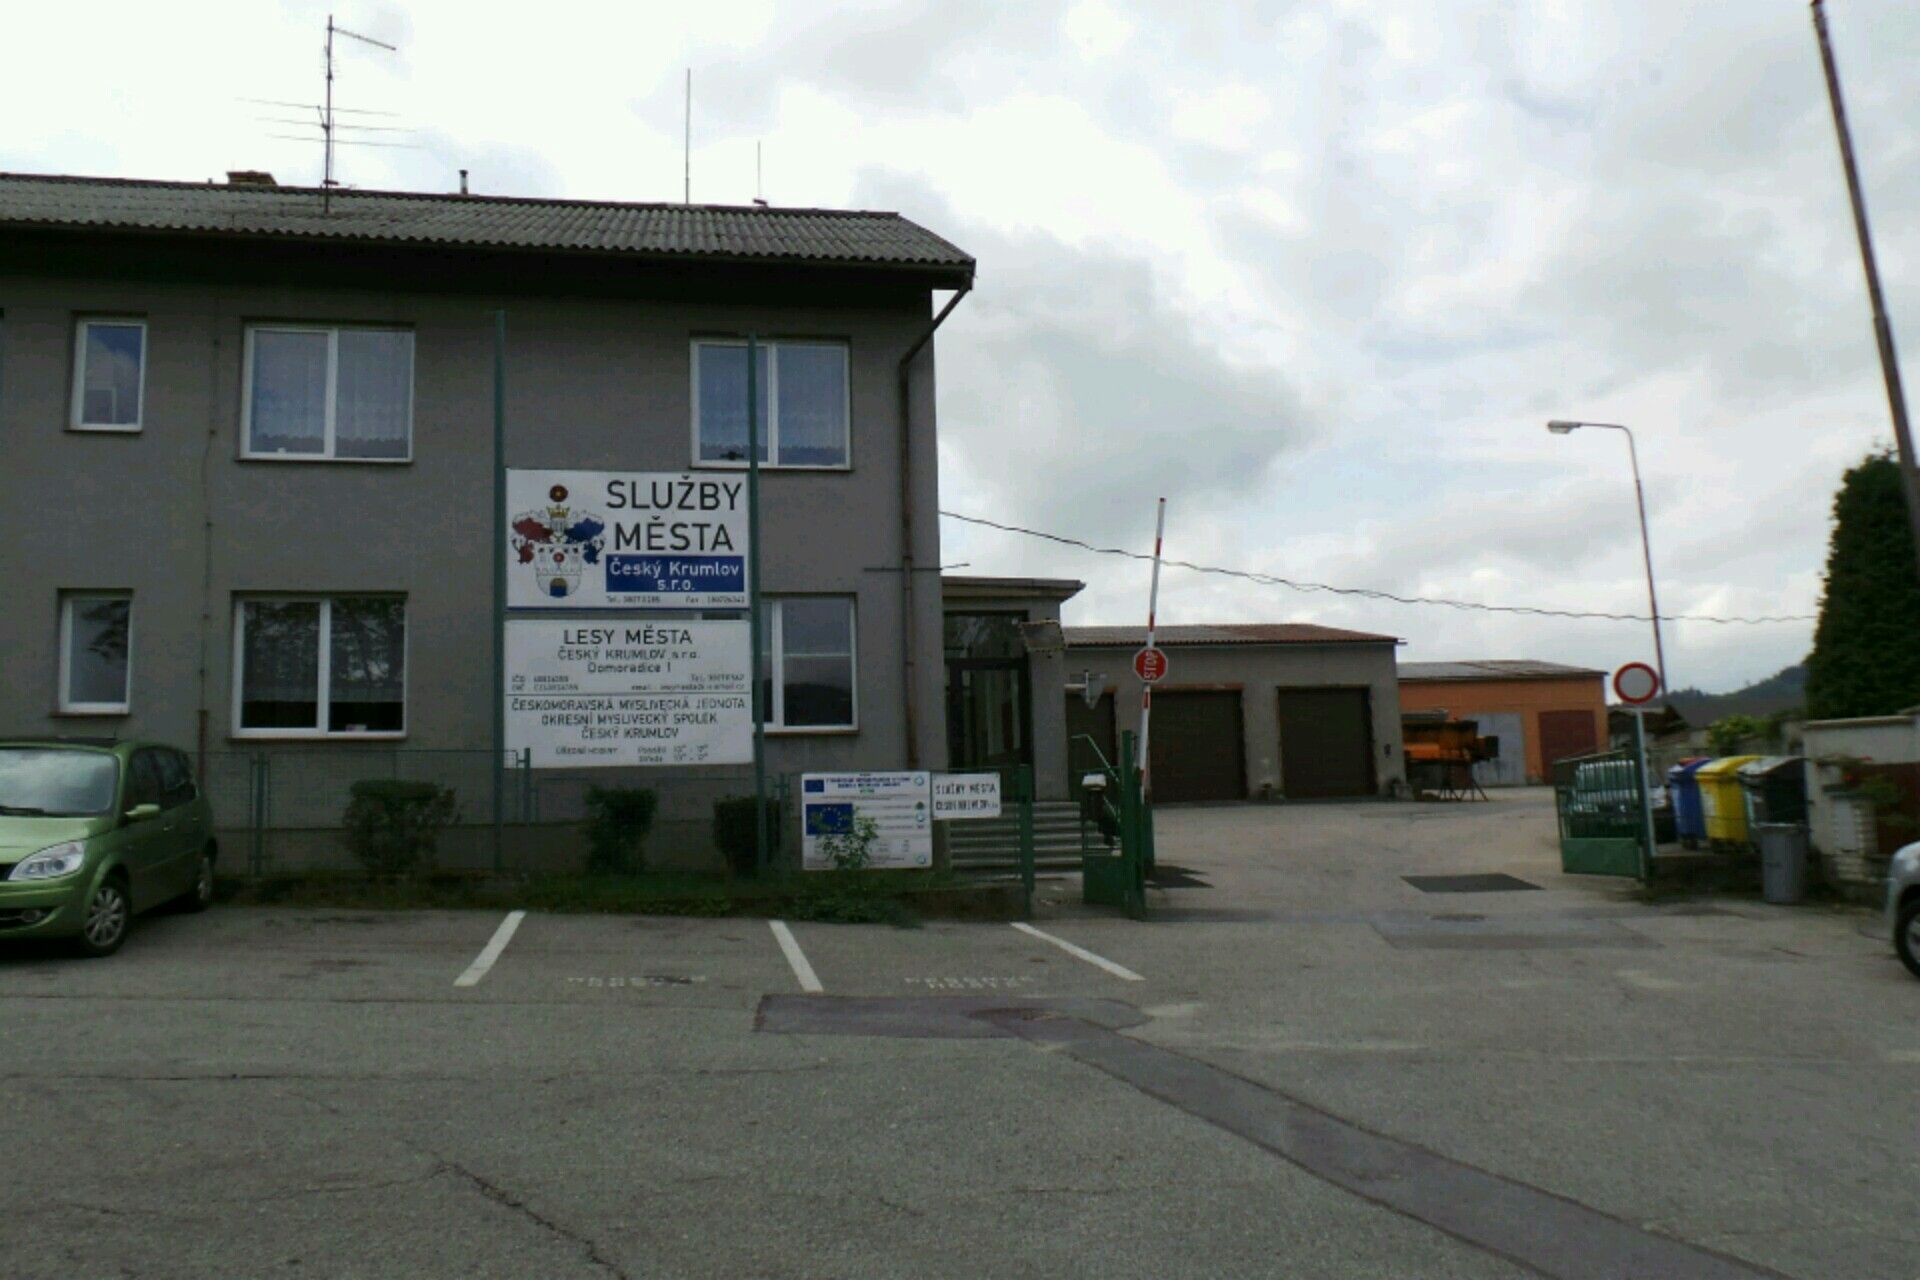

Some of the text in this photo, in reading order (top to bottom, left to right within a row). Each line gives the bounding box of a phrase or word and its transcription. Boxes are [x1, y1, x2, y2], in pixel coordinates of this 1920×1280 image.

[606, 475, 742, 510] SLUŽBY
[615, 516, 734, 551] MĚSTA
[610, 558, 740, 579] Český Krumlov
[657, 580, 695, 591] s.r.o.
[563, 624, 692, 645] LESY MĚSTA
[558, 646, 600, 660] ČESKÝ
[605, 649, 666, 660] KRUMLOV
[587, 662, 661, 673] Domoradice
[1144, 650, 1158, 679] STOP
[512, 696, 745, 711] ČESKOMORAVSKÁ MYSLIVECKÁ JEDNOTA
[541, 711, 717, 725] OKRESNÍ MYSLIVECKÝ SPOLEK
[581, 726, 679, 739] ČESKÝ KRUMLOV
